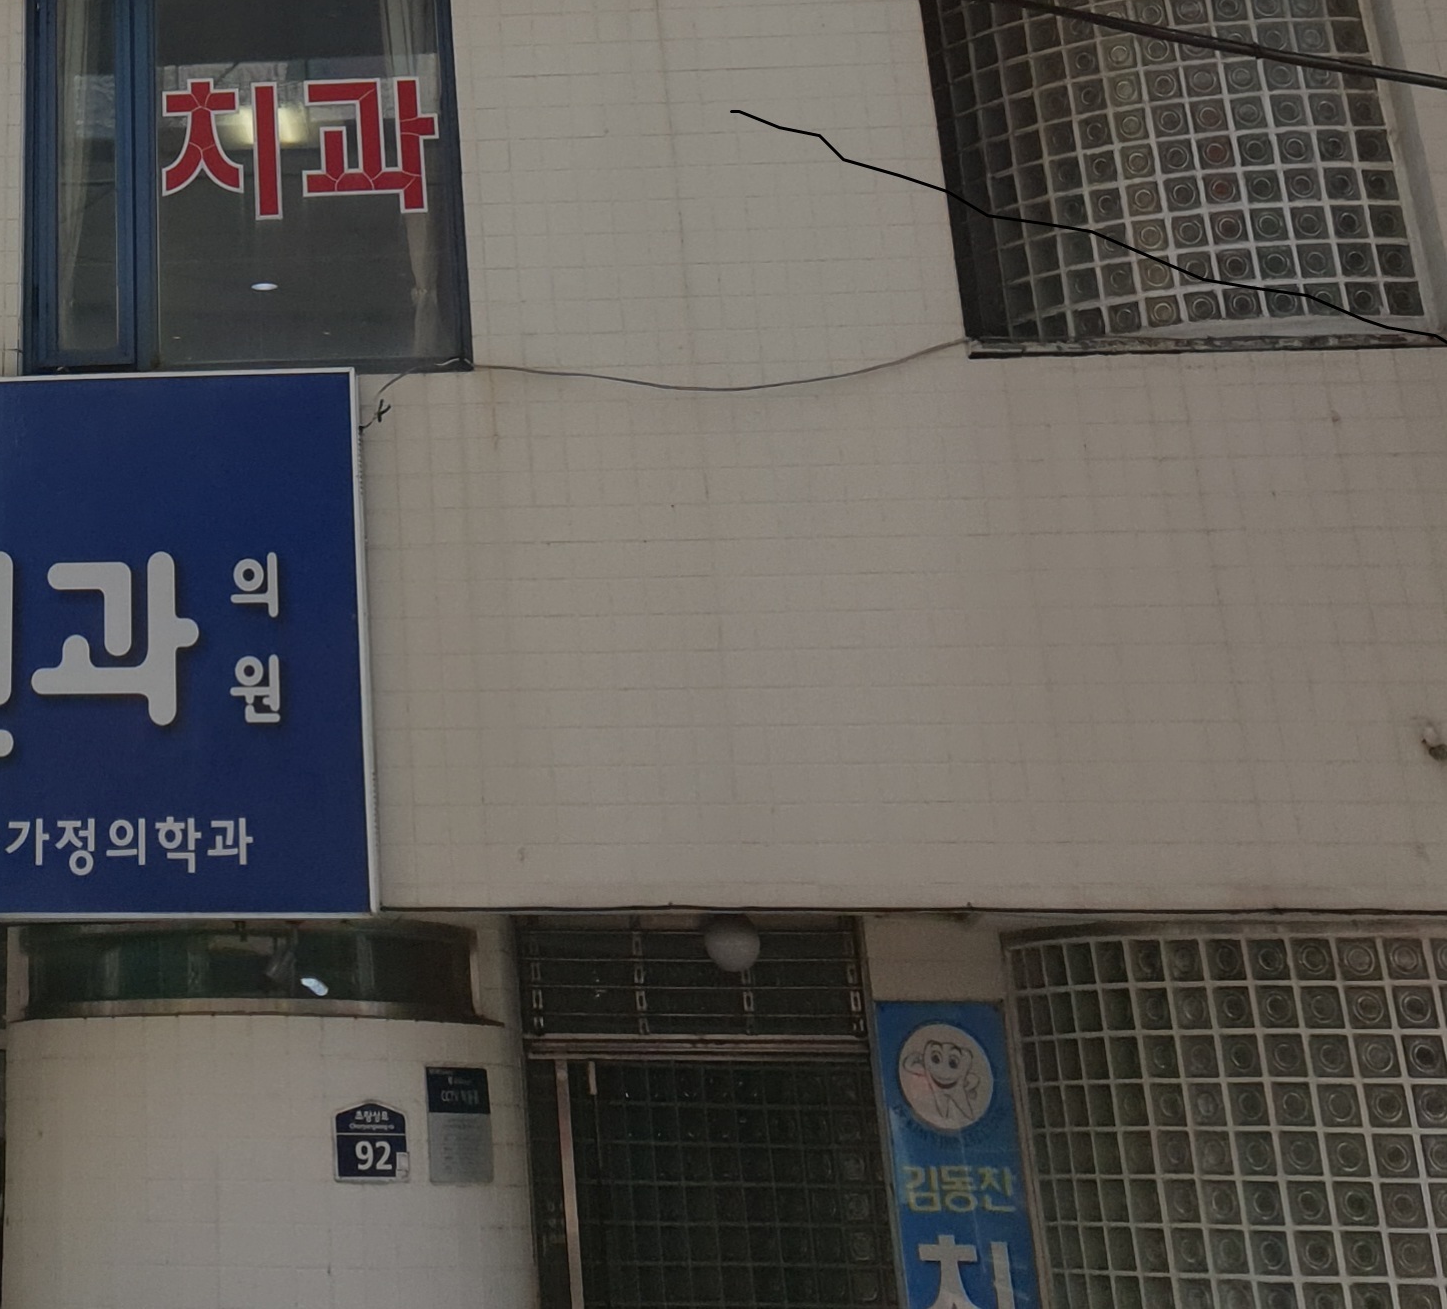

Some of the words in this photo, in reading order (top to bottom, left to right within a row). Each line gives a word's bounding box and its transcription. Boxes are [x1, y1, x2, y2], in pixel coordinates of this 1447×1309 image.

[162, 77, 439, 221] 치과
[230, 551, 281, 723] 의원
[355, 1140, 393, 1171] 92
